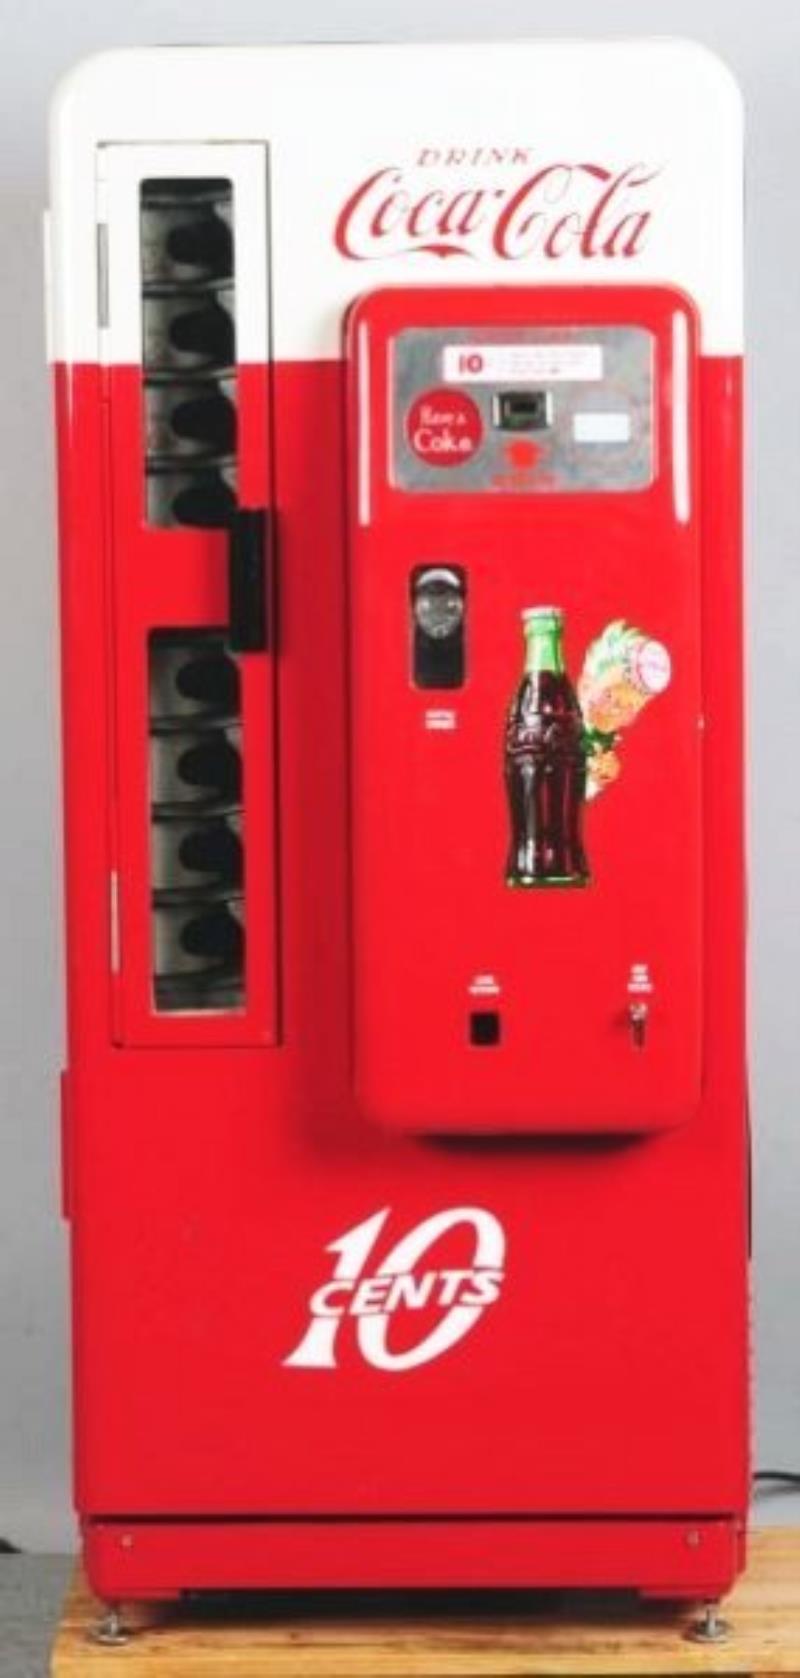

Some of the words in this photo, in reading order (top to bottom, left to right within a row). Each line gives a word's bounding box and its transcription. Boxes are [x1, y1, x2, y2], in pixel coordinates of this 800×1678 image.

[416, 147, 534, 168] DRINK
[458, 354, 484, 374] 10
[413, 428, 473, 453] Coke
[281, 1206, 507, 1372] 10
[308, 1268, 506, 1317] CENTS
